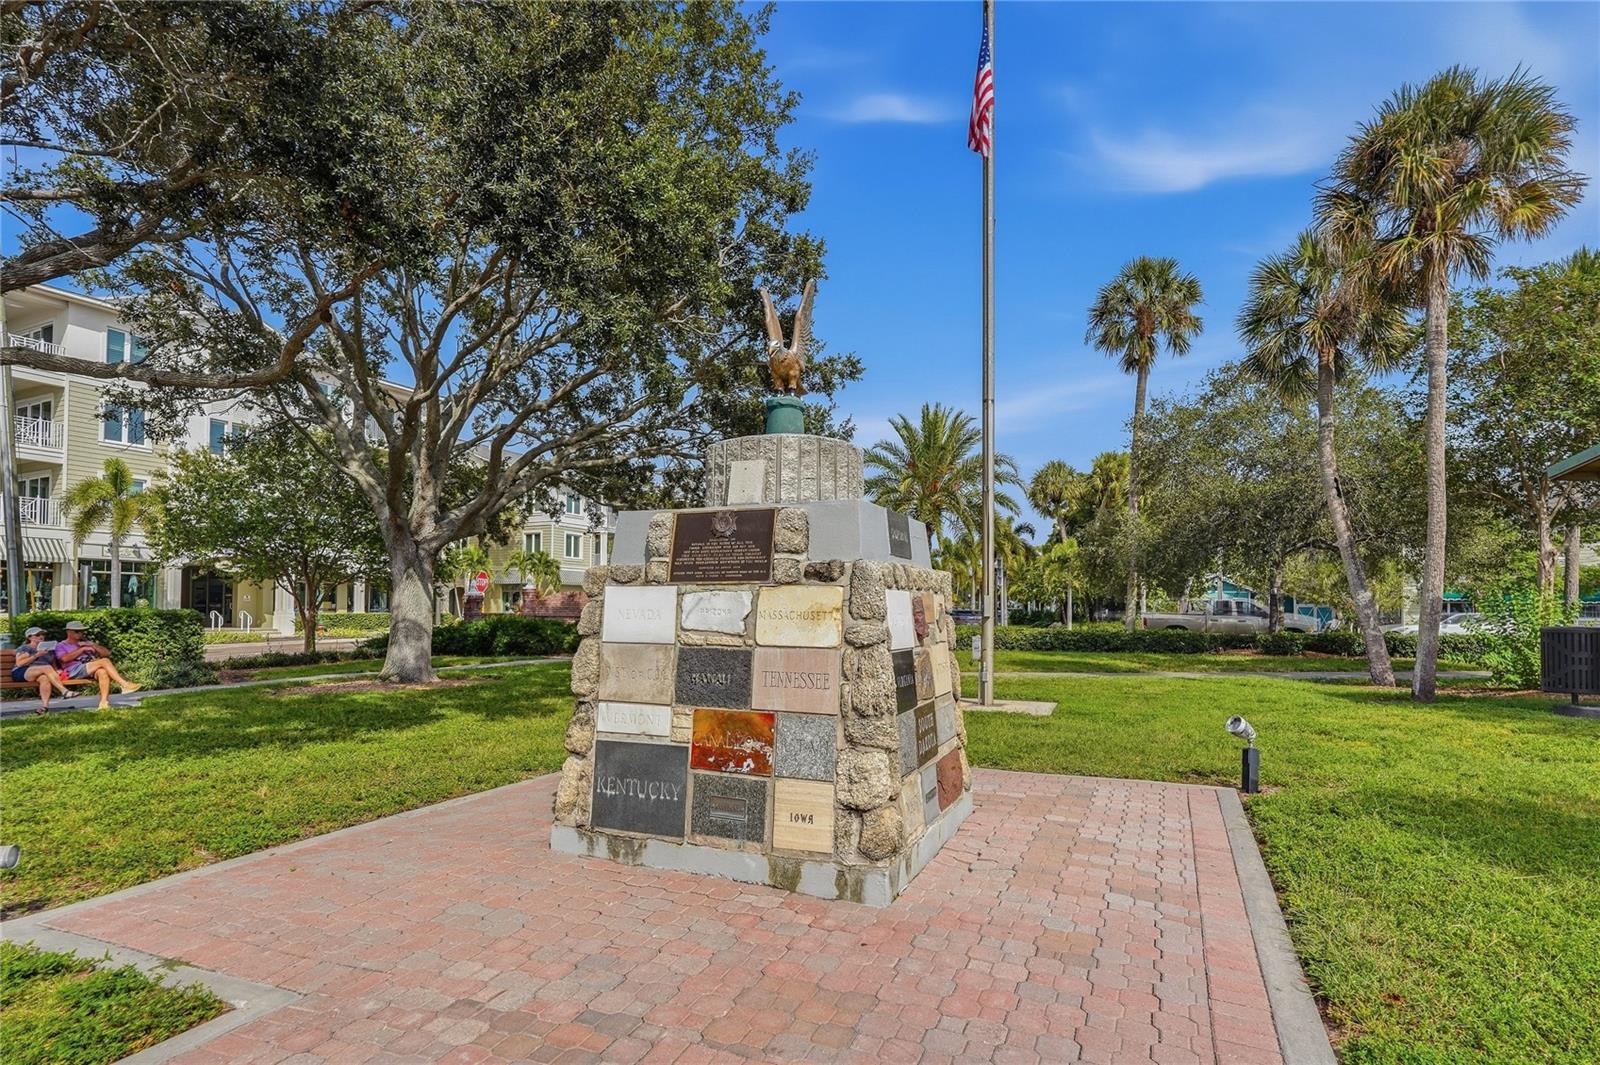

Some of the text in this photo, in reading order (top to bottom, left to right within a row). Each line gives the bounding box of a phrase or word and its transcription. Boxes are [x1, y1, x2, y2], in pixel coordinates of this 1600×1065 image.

[618, 608, 662, 621] NEVADA
[762, 670, 831, 691] TENNESSEE
[602, 708, 663, 728] VERMONT
[596, 775, 682, 801] KENTUCKY
[789, 812, 815, 825] IOWA
